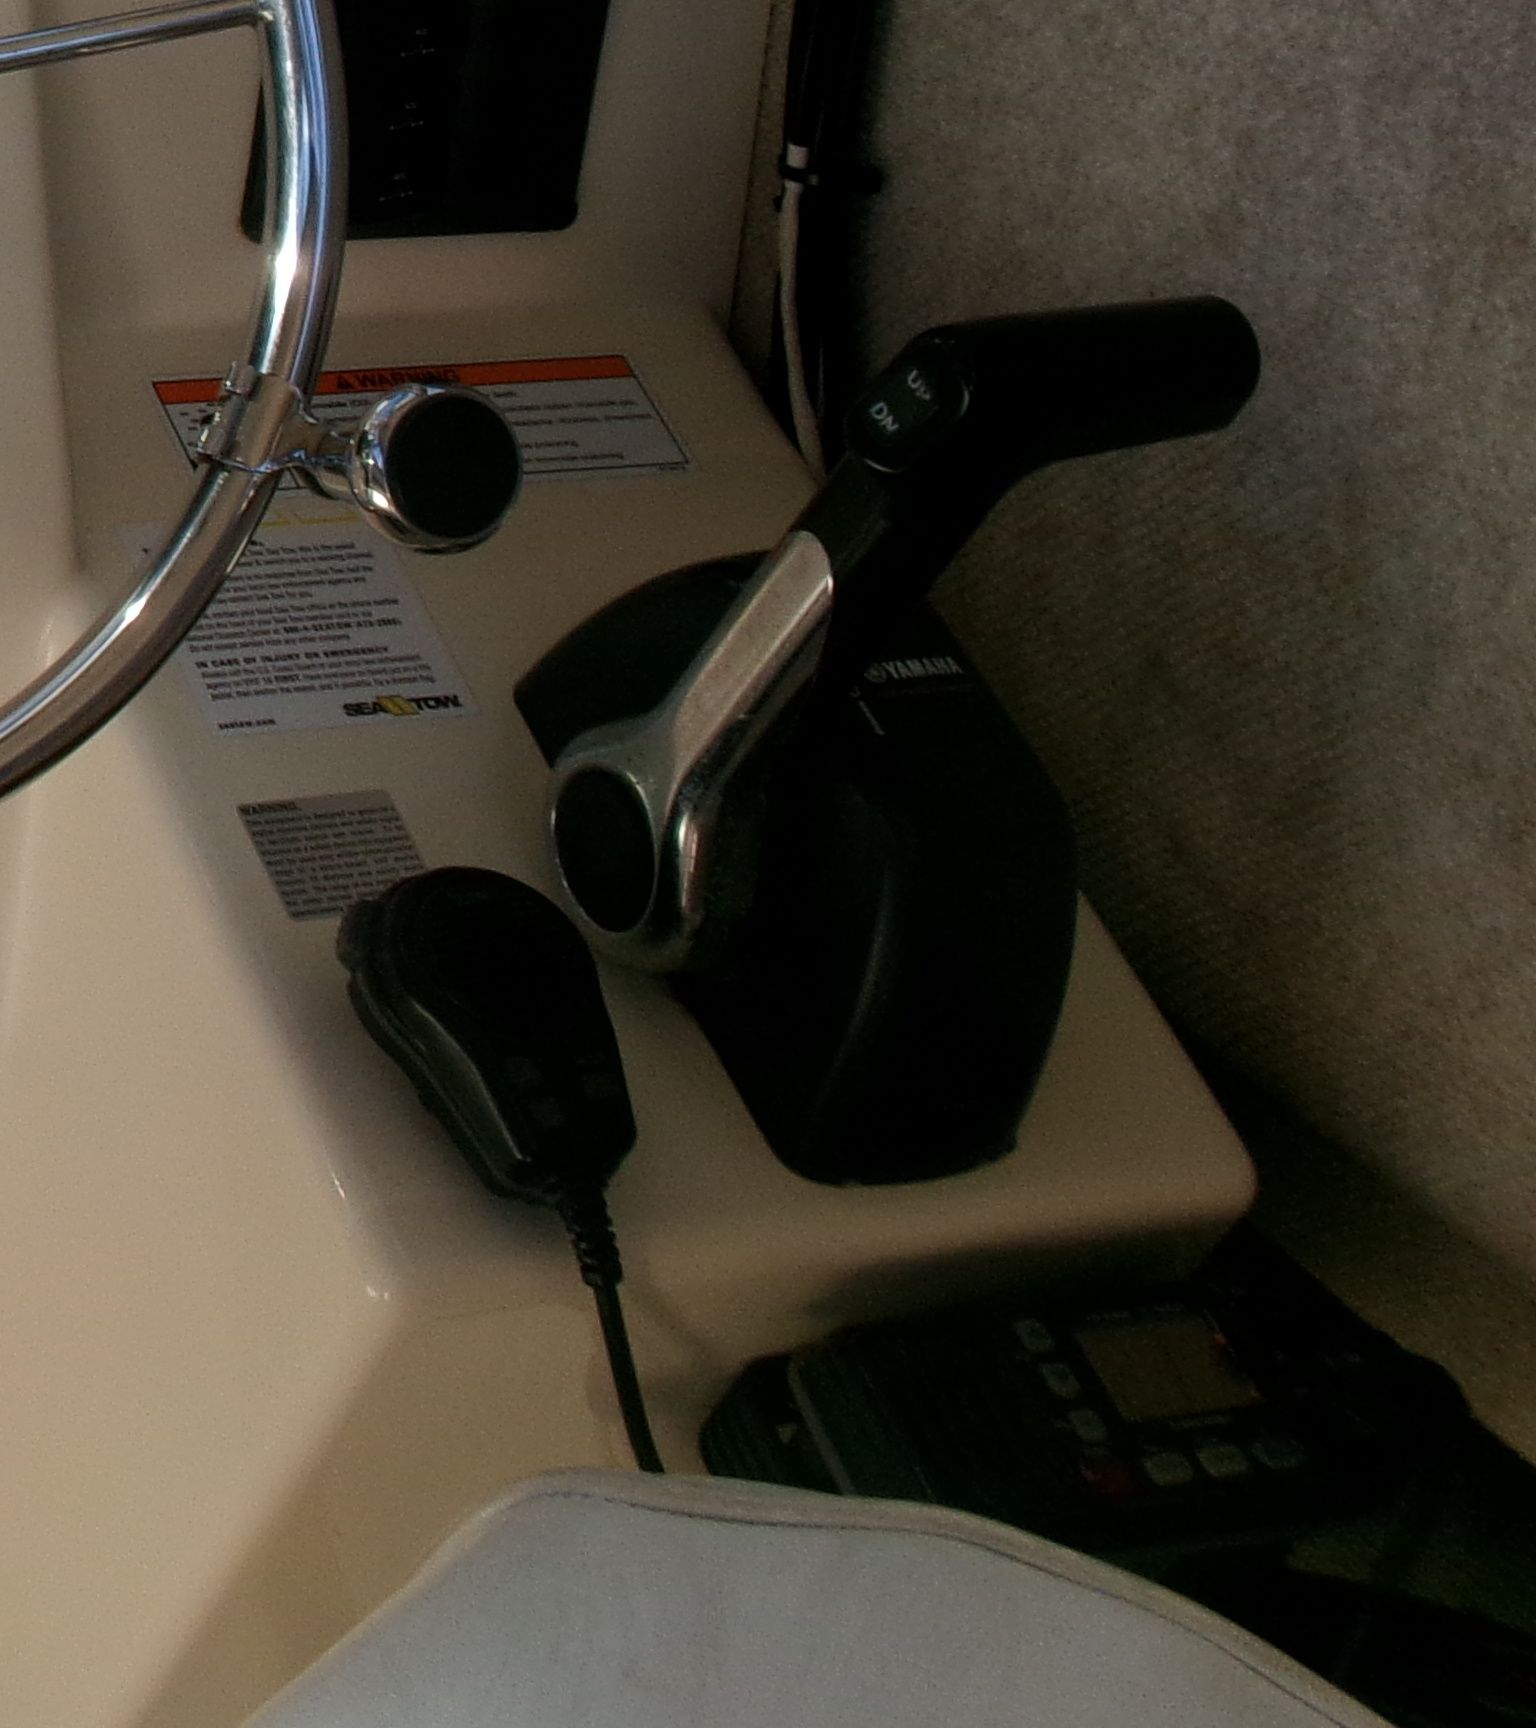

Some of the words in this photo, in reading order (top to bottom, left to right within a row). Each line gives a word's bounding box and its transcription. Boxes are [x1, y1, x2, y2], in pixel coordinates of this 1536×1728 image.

[907, 369, 932, 400] UP
[870, 402, 900, 432] DN
[881, 656, 964, 679] YAMAHA
[342, 701, 384, 717] SEA
[408, 694, 463, 711] TOW
